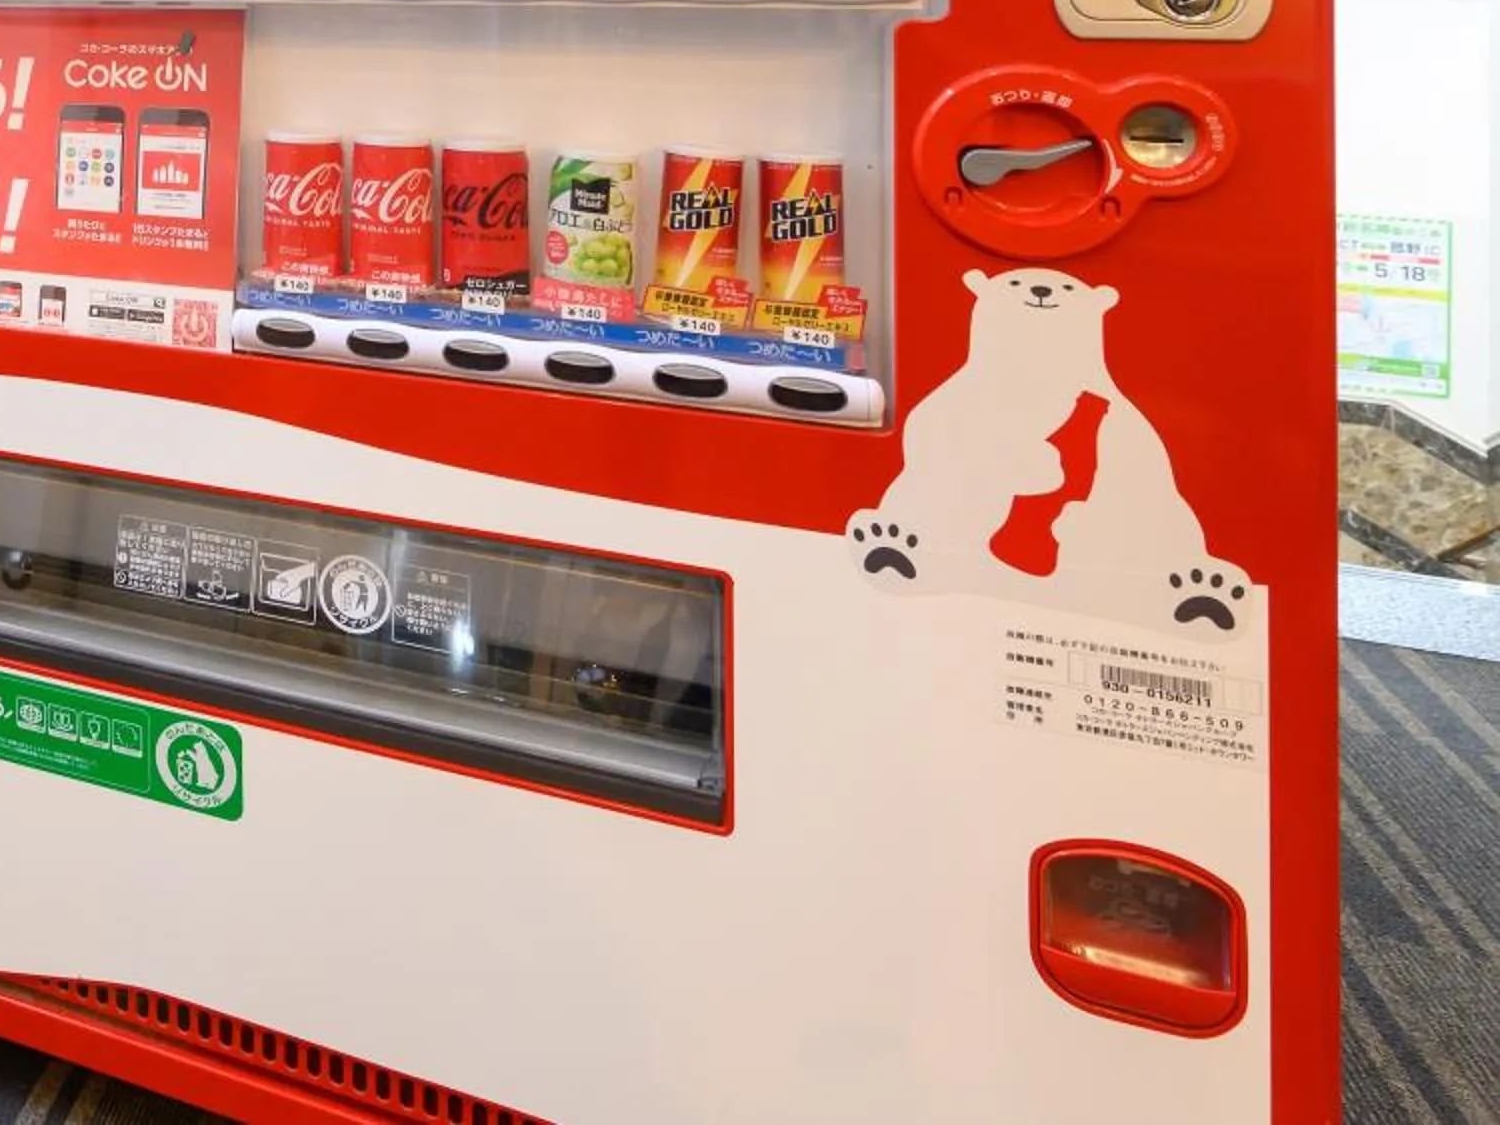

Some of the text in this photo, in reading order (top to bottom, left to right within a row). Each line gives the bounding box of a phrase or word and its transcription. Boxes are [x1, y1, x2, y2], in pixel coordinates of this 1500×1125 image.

[63, 55, 209, 92] Coke ON
[670, 181, 735, 211] REAL
[770, 187, 837, 221] REAL
[668, 209, 735, 232] GOLD
[770, 213, 838, 243] GOLD
[279, 279, 310, 291] ¥140
[465, 278, 528, 290] ゼロシュガー
[371, 288, 403, 301] ¥140
[467, 296, 501, 309] ¥140
[566, 307, 601, 320] ¥140
[680, 319, 717, 334] ¥140
[790, 330, 830, 346] ¥140
